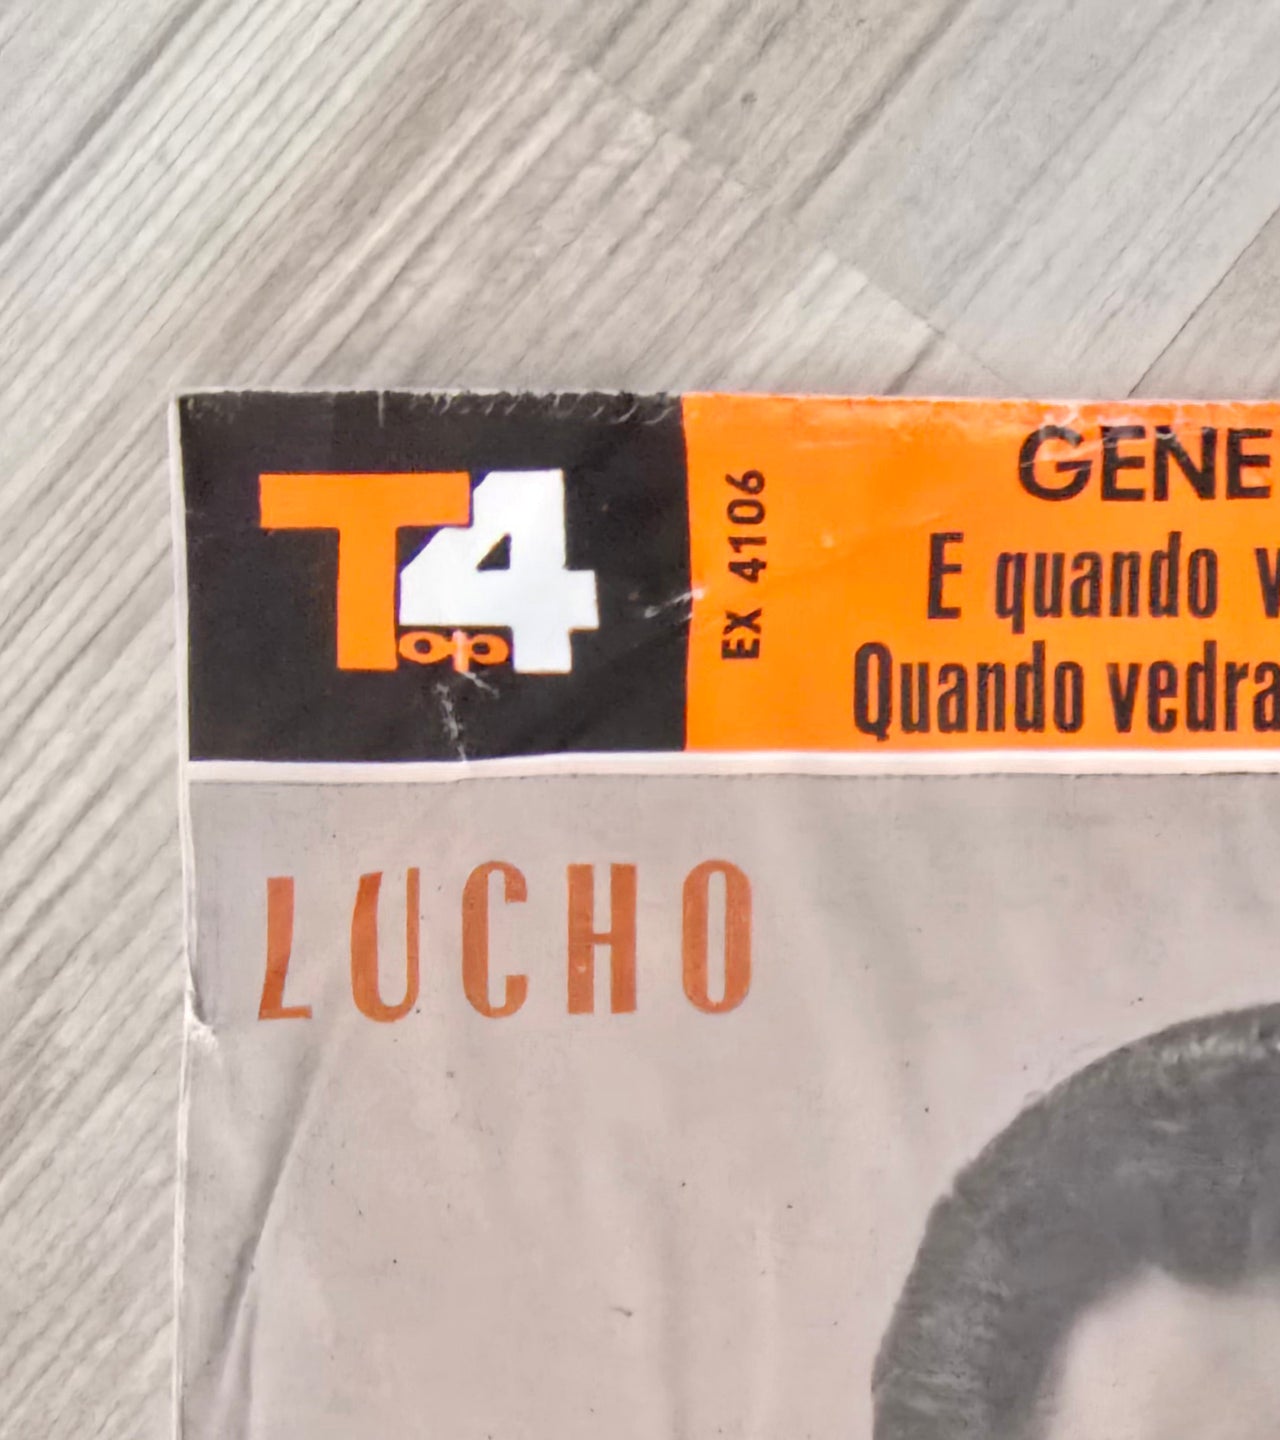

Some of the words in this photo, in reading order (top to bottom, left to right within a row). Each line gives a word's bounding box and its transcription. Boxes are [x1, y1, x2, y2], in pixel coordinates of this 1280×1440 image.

[1020, 426, 1268, 500] GENE
[727, 470, 767, 582] 4106
[929, 534, 961, 618] E
[997, 532, 1216, 632] quando
[721, 609, 761, 660] EX
[855, 643, 1082, 739] Quando
[258, 858, 753, 1024] LUCHO
